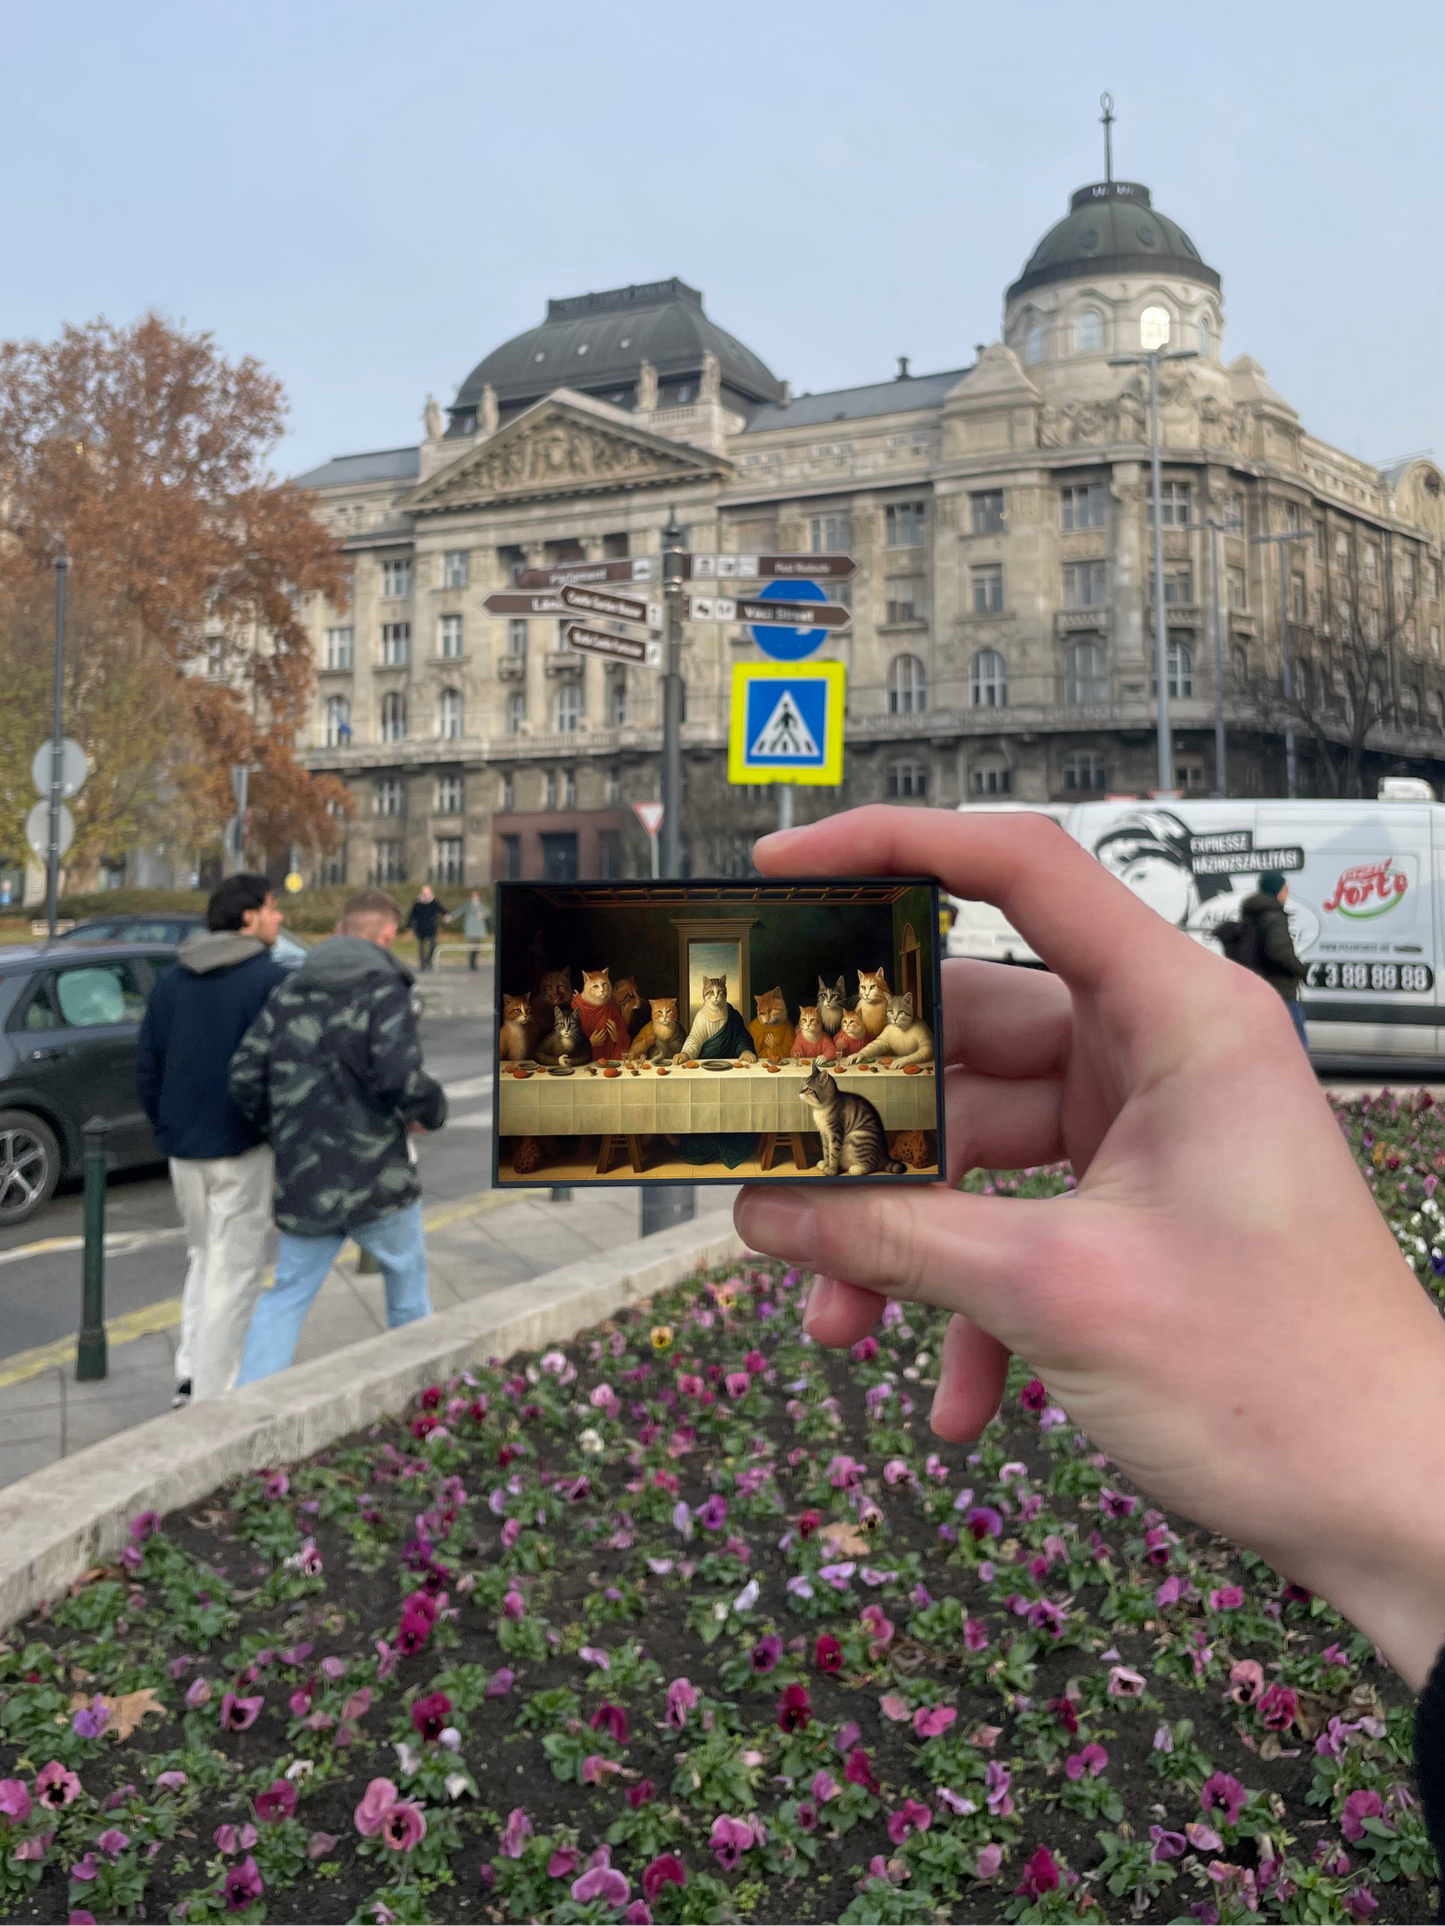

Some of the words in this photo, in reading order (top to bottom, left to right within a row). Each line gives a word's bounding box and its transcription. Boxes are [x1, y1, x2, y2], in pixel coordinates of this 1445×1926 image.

[775, 607, 815, 622] Street
[1190, 832, 1247, 853] EXPRESSZ
[1325, 962, 1338, 988] 3
[1342, 963, 1367, 989] 88
[1371, 963, 1397, 990] 88
[1401, 964, 1427, 991] 88
